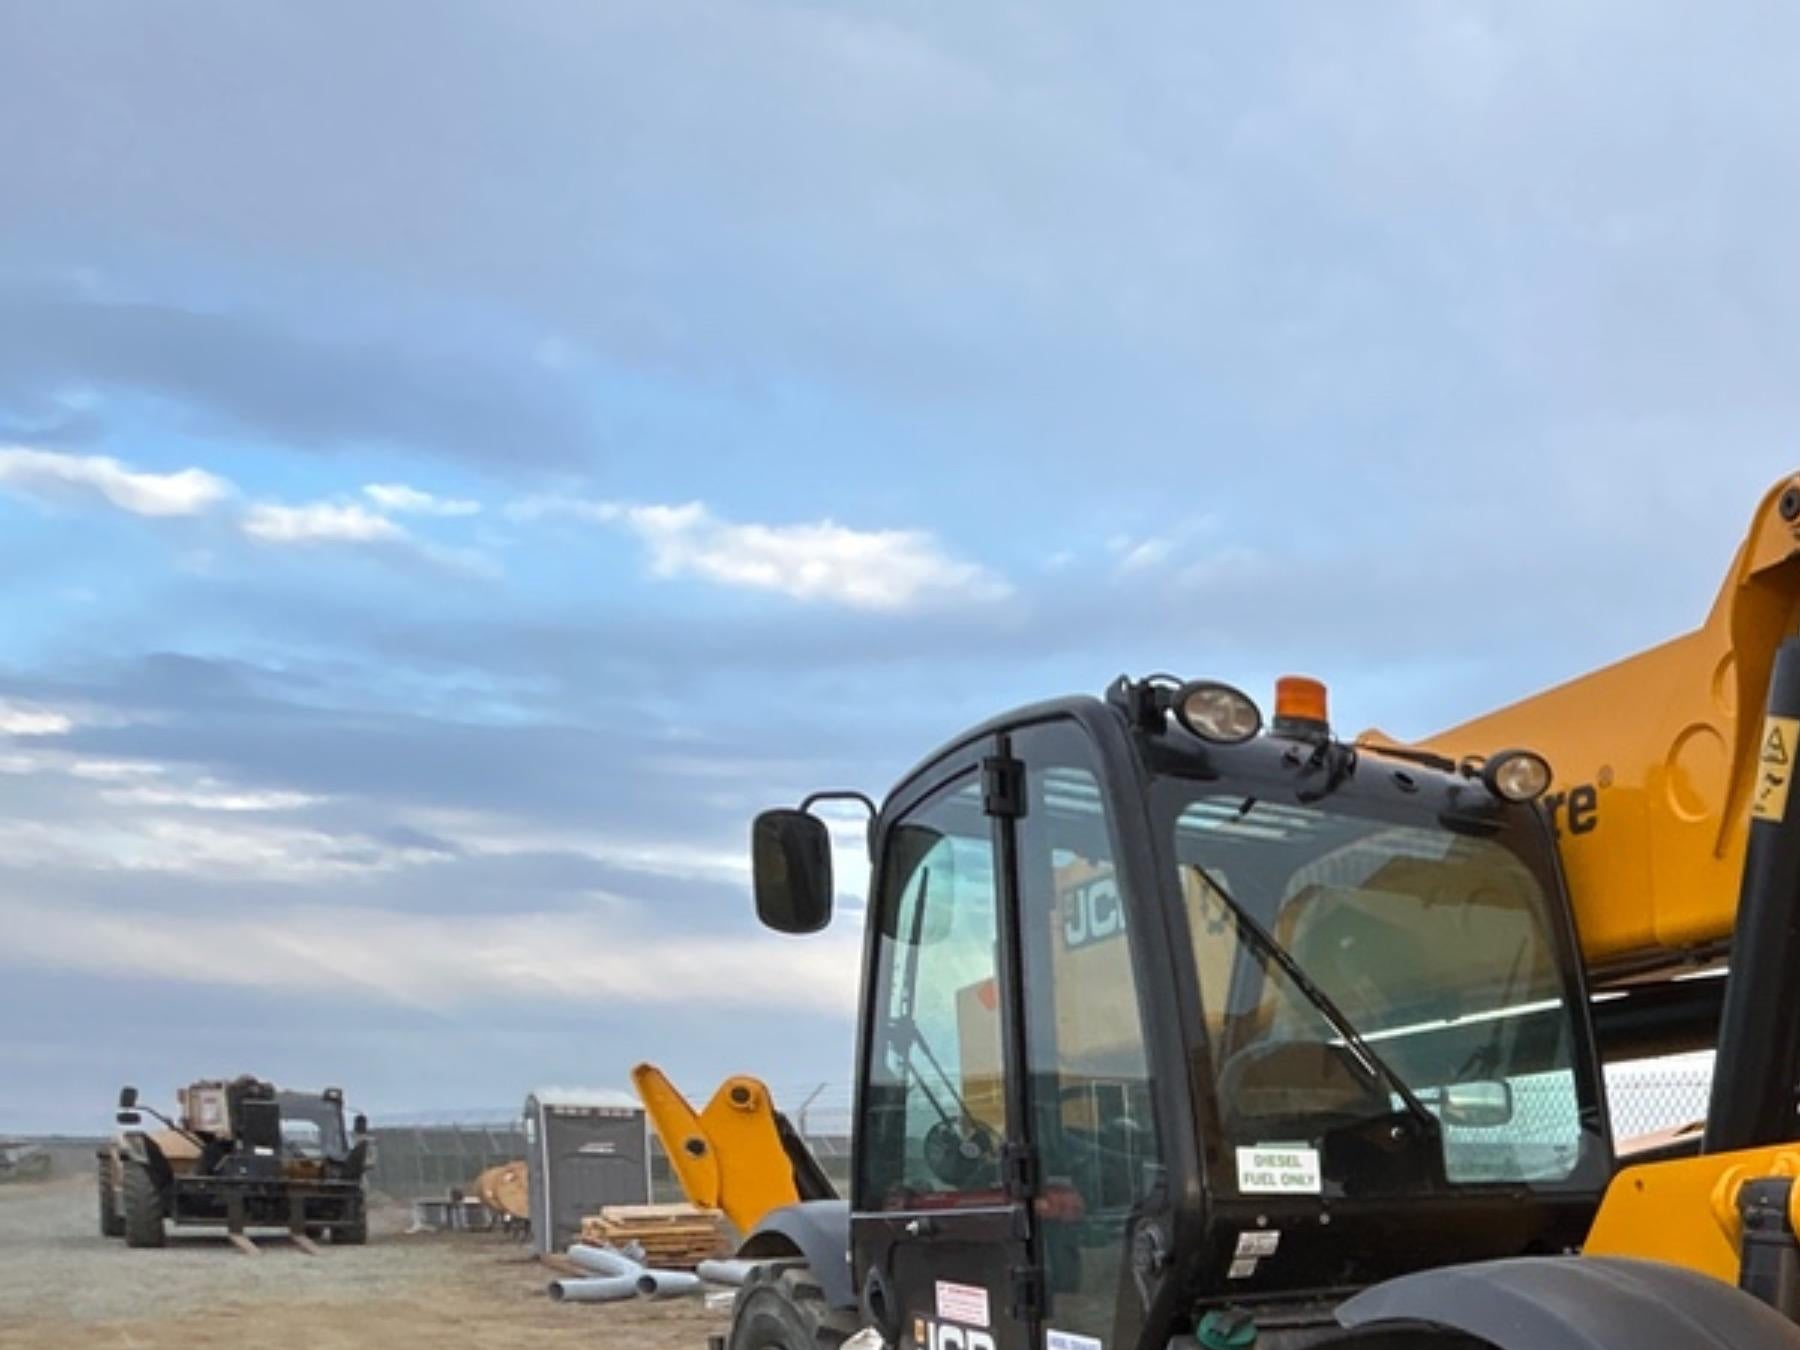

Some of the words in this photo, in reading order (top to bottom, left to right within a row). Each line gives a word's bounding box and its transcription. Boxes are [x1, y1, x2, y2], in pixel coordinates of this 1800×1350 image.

[1063, 878, 1126, 946] JC
[1253, 1153, 1303, 1169] DIESEL
[1244, 1171, 1277, 1186] FUEL
[1280, 1172, 1316, 1186] ONLY
